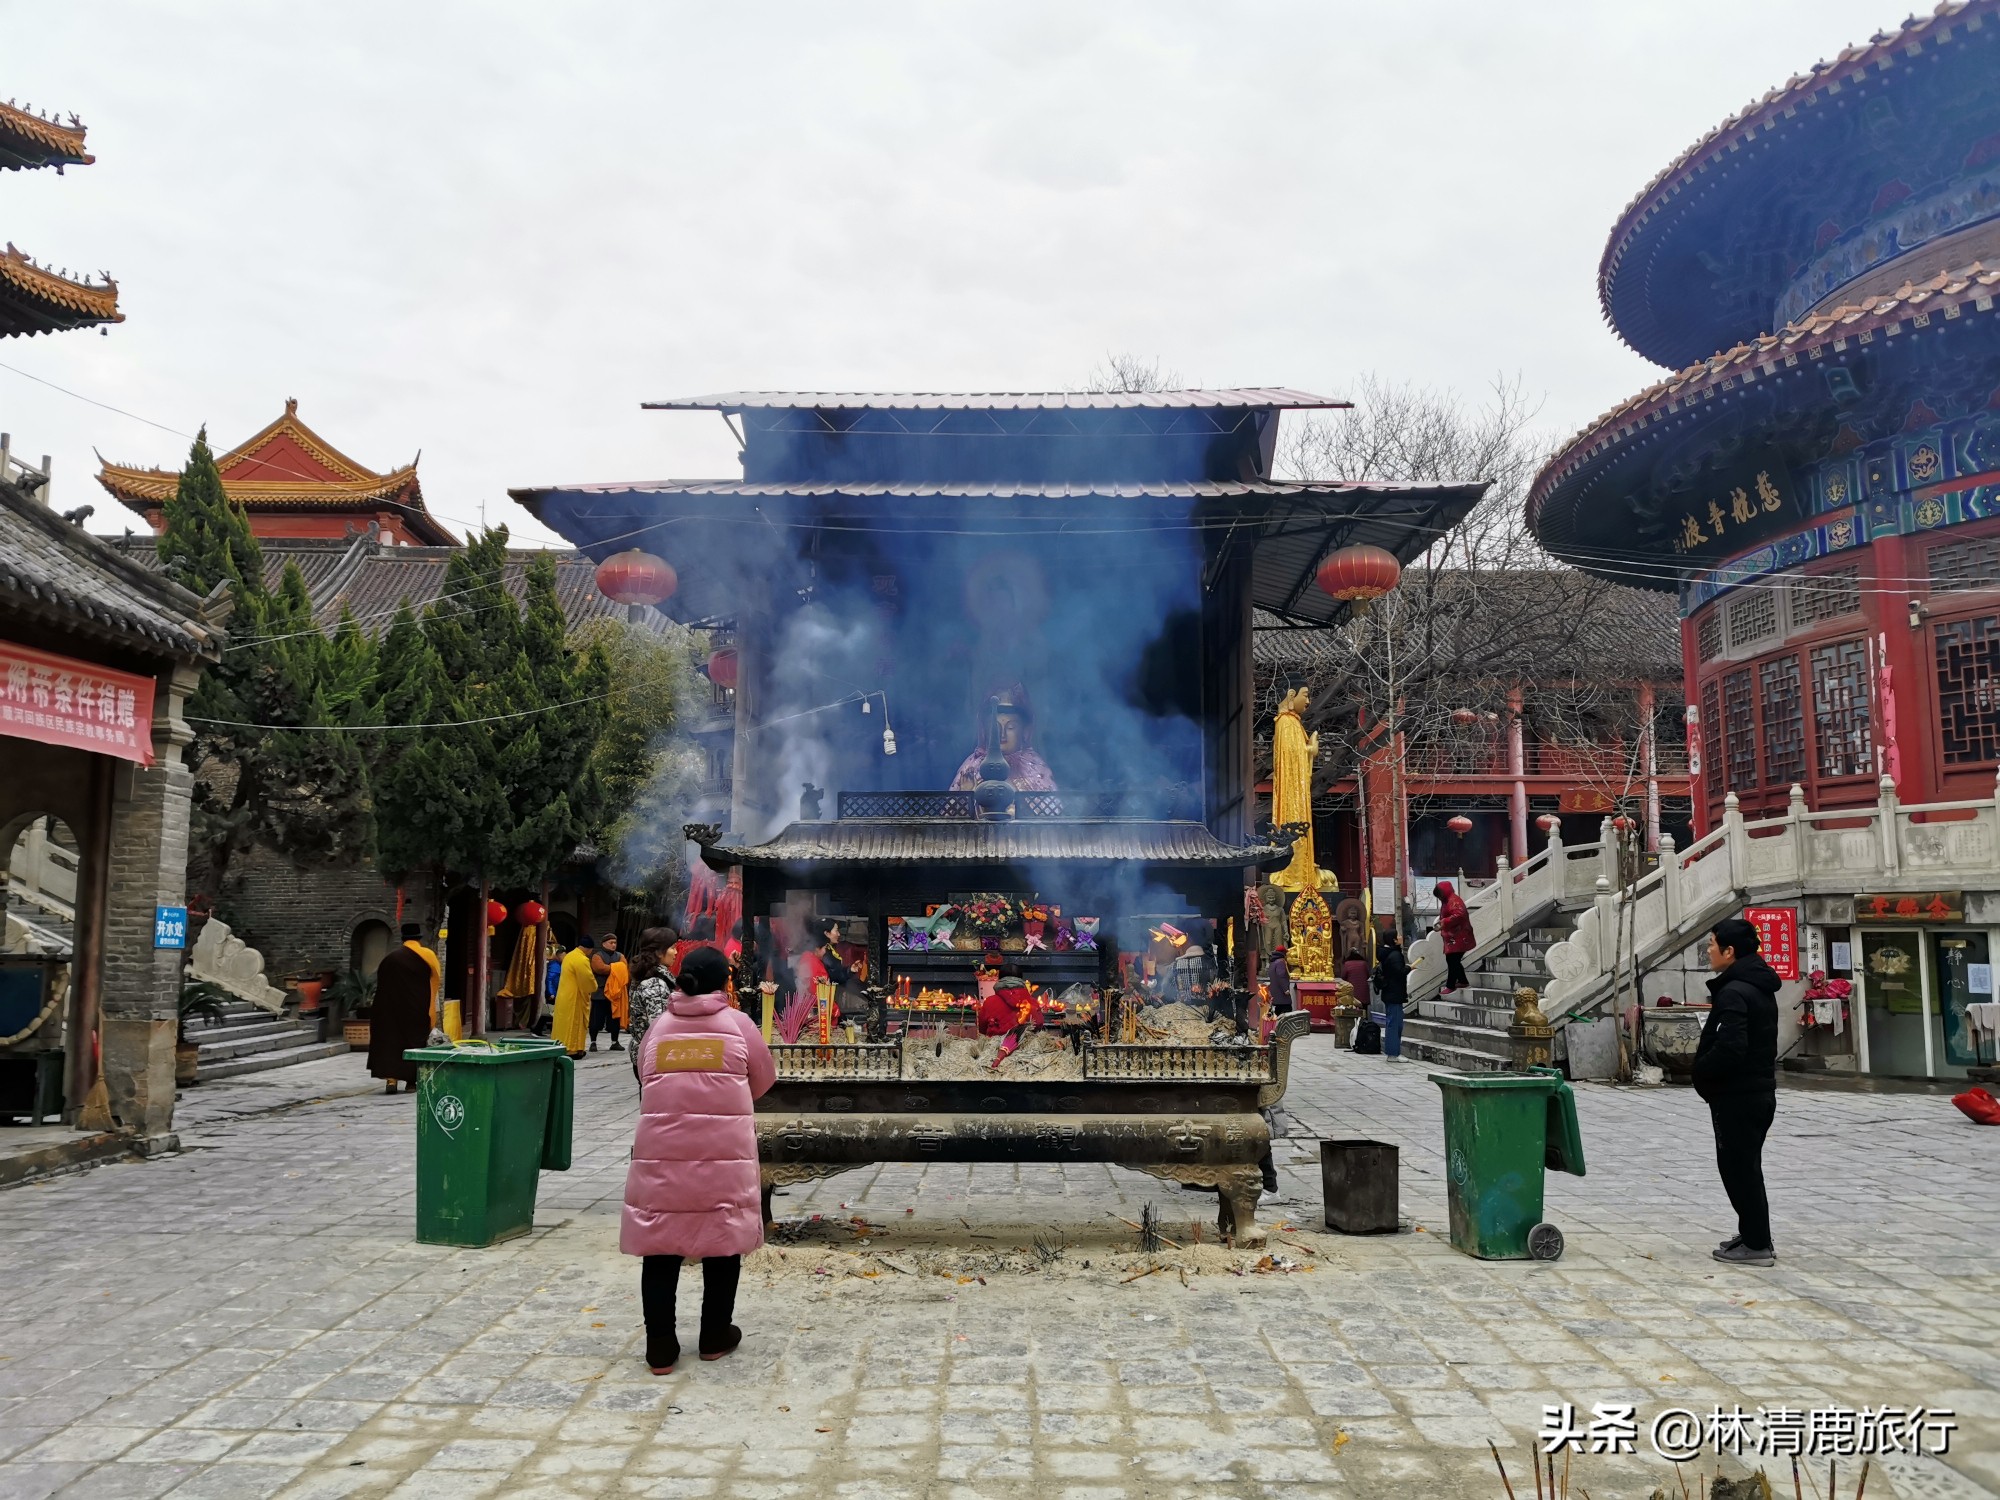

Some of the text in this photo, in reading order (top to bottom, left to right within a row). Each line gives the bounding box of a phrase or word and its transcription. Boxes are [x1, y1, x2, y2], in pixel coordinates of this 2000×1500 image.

[0, 661, 136, 728] 附带条件捐赠
[3, 705, 126, 745] 顺河回族区民族宗教事务局
[156, 920, 184, 937] 开水处
